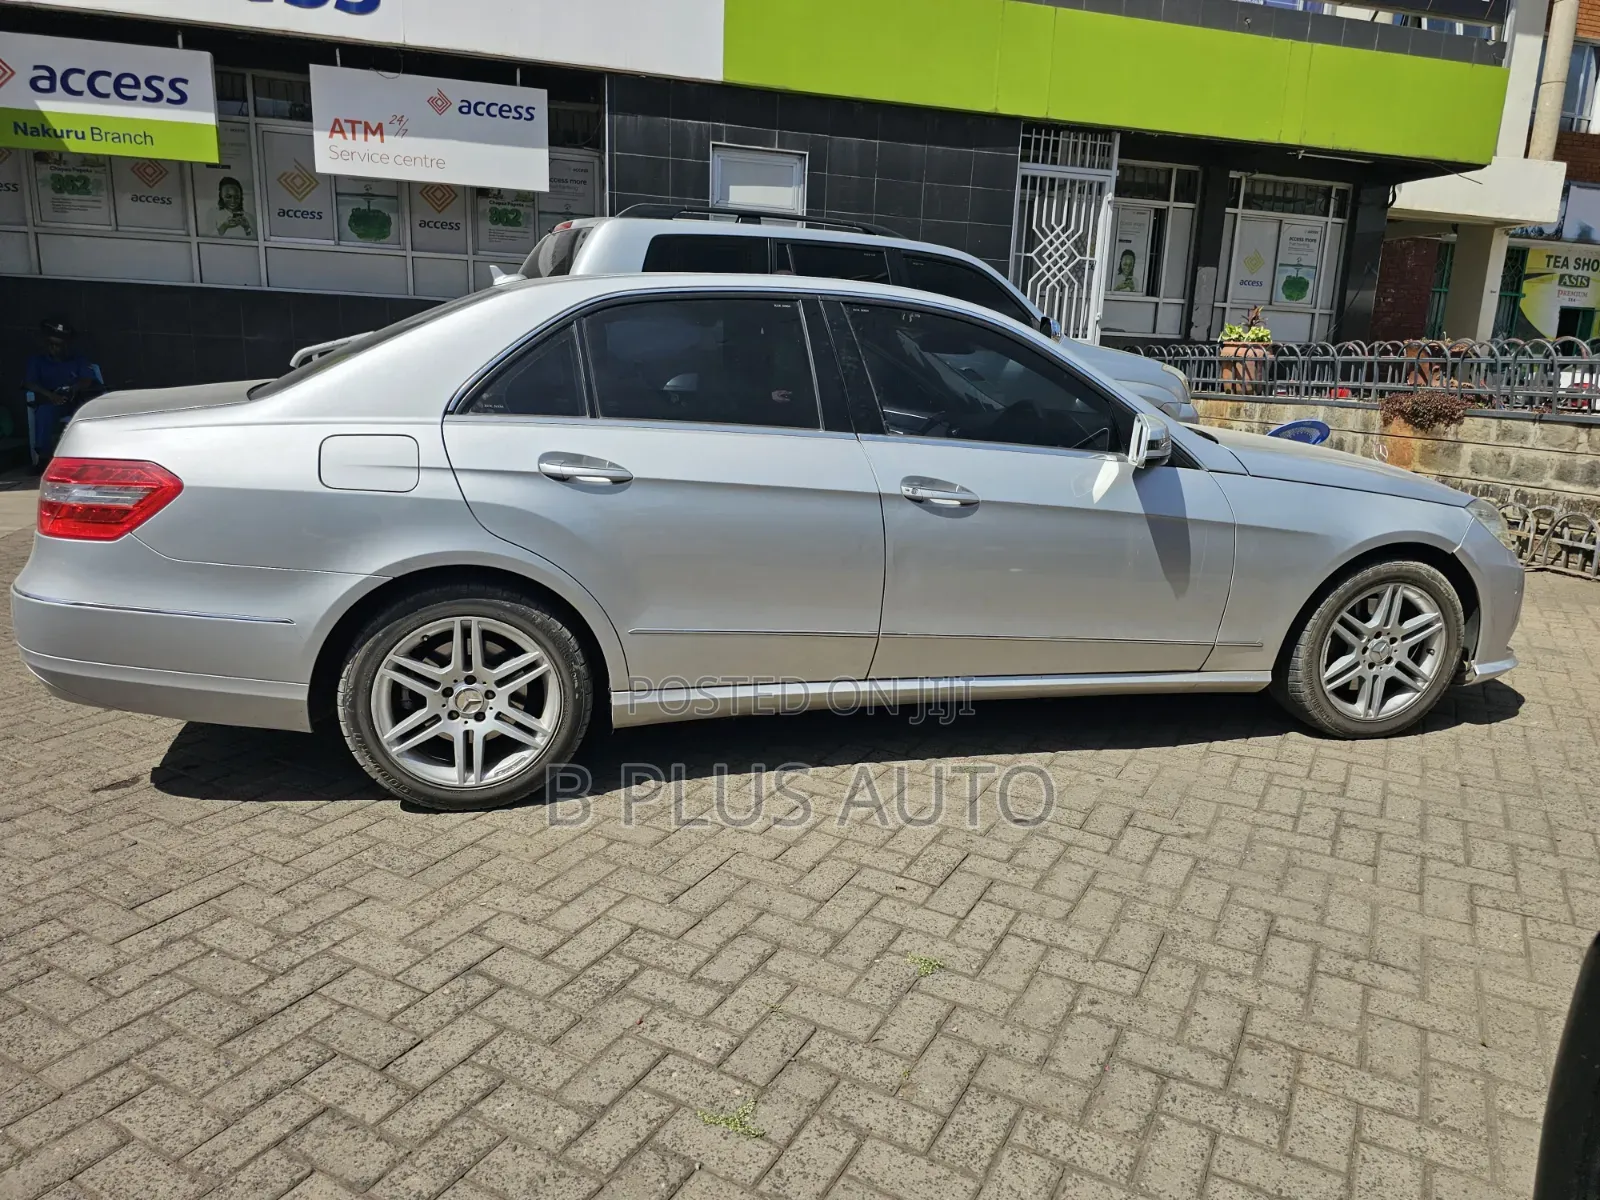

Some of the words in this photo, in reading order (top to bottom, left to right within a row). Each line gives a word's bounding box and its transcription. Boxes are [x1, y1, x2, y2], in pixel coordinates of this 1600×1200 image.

[29, 64, 189, 106] access
[458, 99, 536, 122] access
[13, 121, 86, 141] Nakuru
[90, 126, 155, 147] Branch
[328, 117, 385, 144] ATM
[328, 144, 391, 165] Service
[393, 153, 447, 170] centre
[130, 193, 173, 206] access
[277, 207, 323, 221] access
[418, 219, 461, 232] access
[1545, 254, 1569, 269] TEA
[1573, 257, 1600, 272] SHO
[1239, 279, 1263, 287] access
